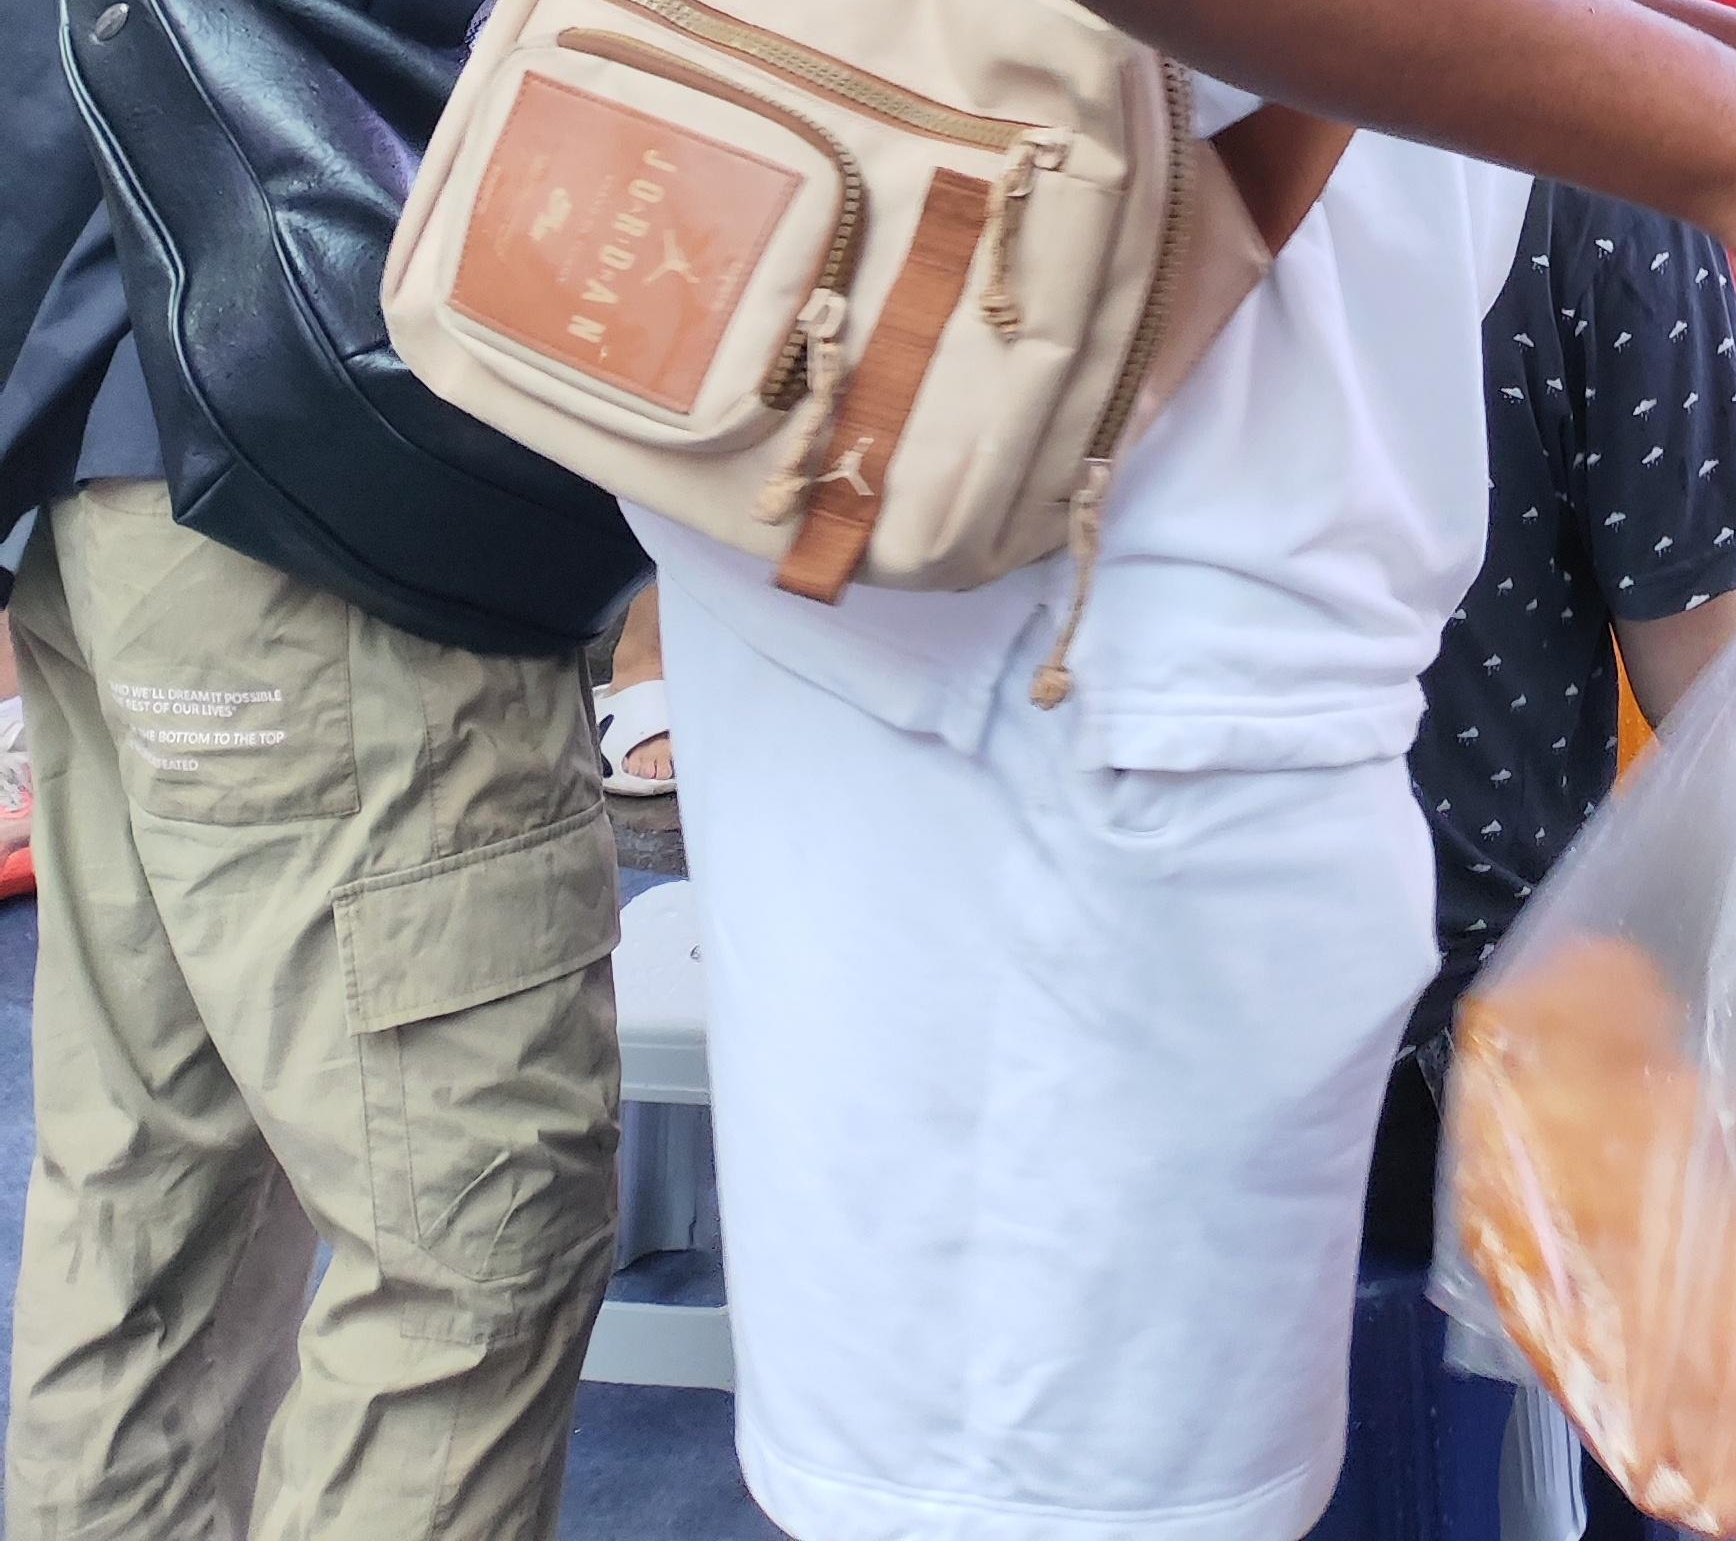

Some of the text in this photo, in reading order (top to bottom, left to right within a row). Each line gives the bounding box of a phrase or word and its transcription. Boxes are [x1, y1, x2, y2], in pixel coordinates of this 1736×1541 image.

[566, 147, 679, 345] JORDAN
[131, 685, 165, 701] WE'LL
[168, 688, 210, 703] DREAM
[223, 688, 283, 705] POSSIBLE
[152, 701, 170, 714] OF
[172, 702, 200, 715] OUR
[158, 730, 210, 745] BOTTOM
[212, 731, 231, 746] TO
[233, 731, 257, 746] THE
[258, 730, 286, 745] TOP
